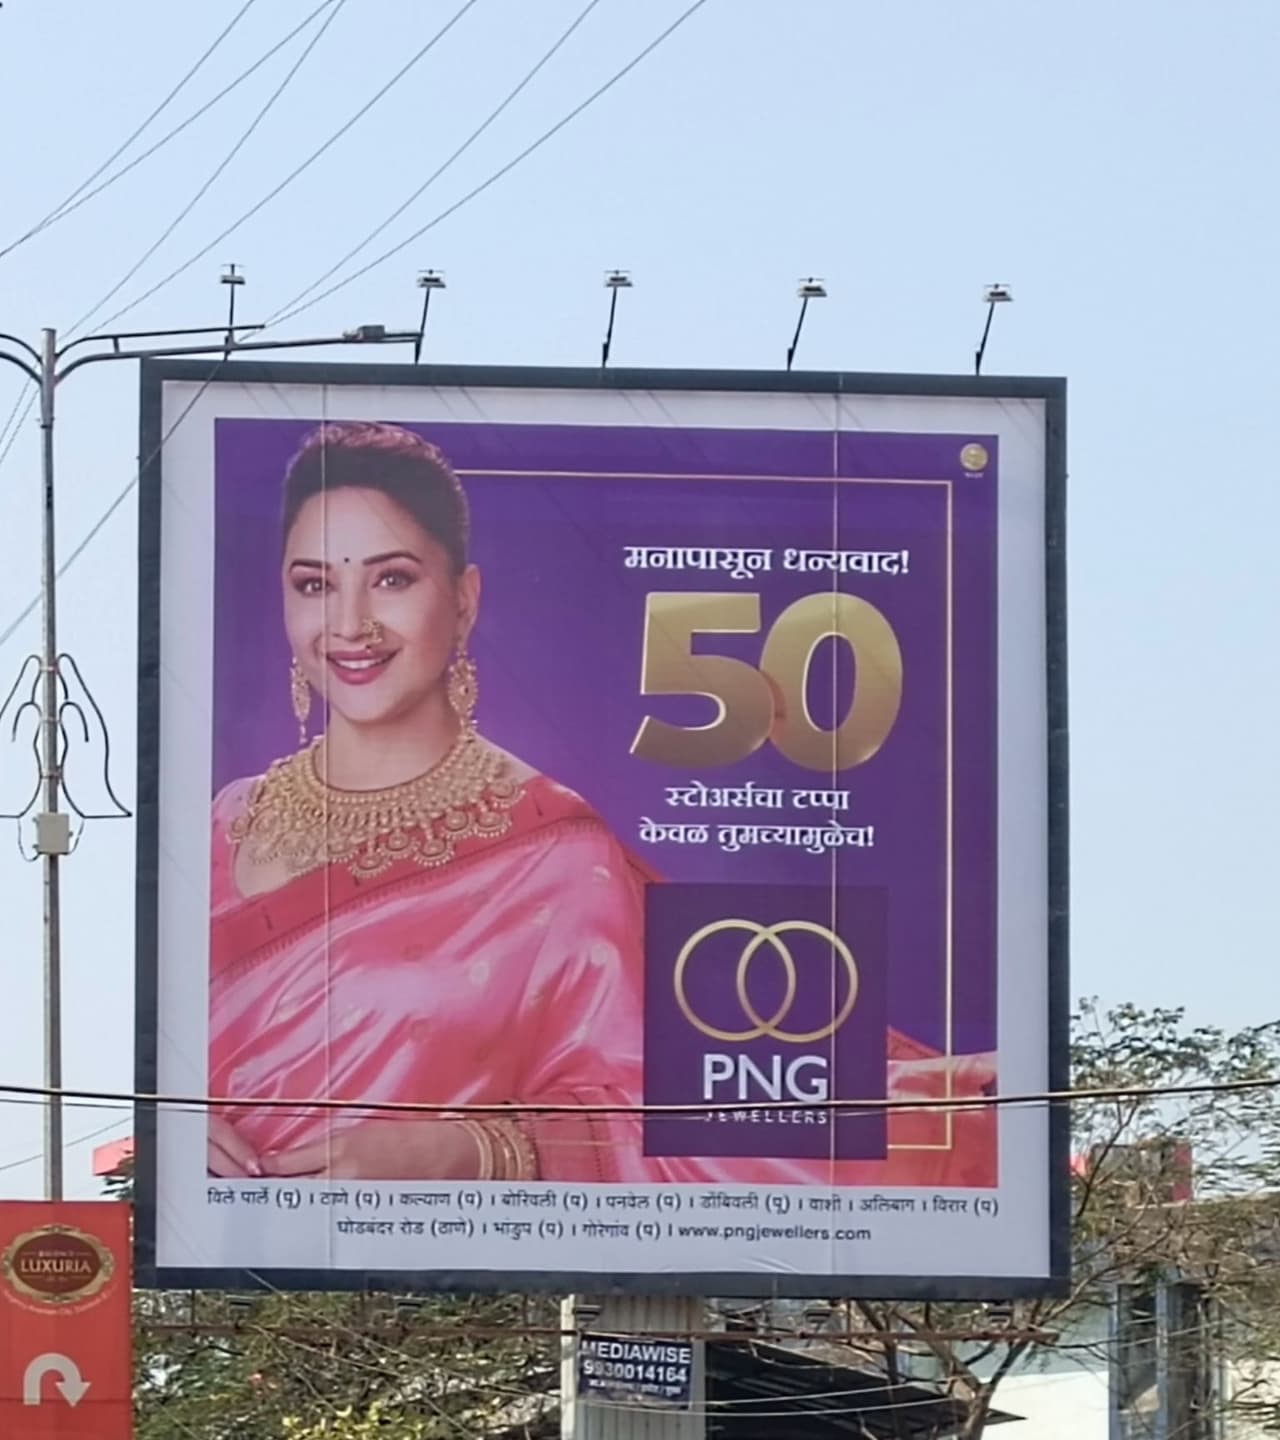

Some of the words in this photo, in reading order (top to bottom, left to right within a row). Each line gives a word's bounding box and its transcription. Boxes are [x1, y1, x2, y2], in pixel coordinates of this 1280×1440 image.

[624, 546, 772, 579] मनापासून
[783, 549, 910, 575] धन्यवाद!
[629, 591, 904, 772] 50
[665, 780, 783, 809] स्टोअर्सचा
[792, 787, 850, 810] टप्पा
[639, 817, 709, 844] केवळ
[717, 821, 874, 855] तुमच्यामुळेच!
[703, 1053, 829, 1103] PNG
[704, 1110, 828, 1125] JEWELLERS
[678, 1224, 872, 1242] www.pngjewellers.com
[21, 1258, 93, 1273] LUXURIA
[581, 1340, 692, 1364] MEDIAWISE
